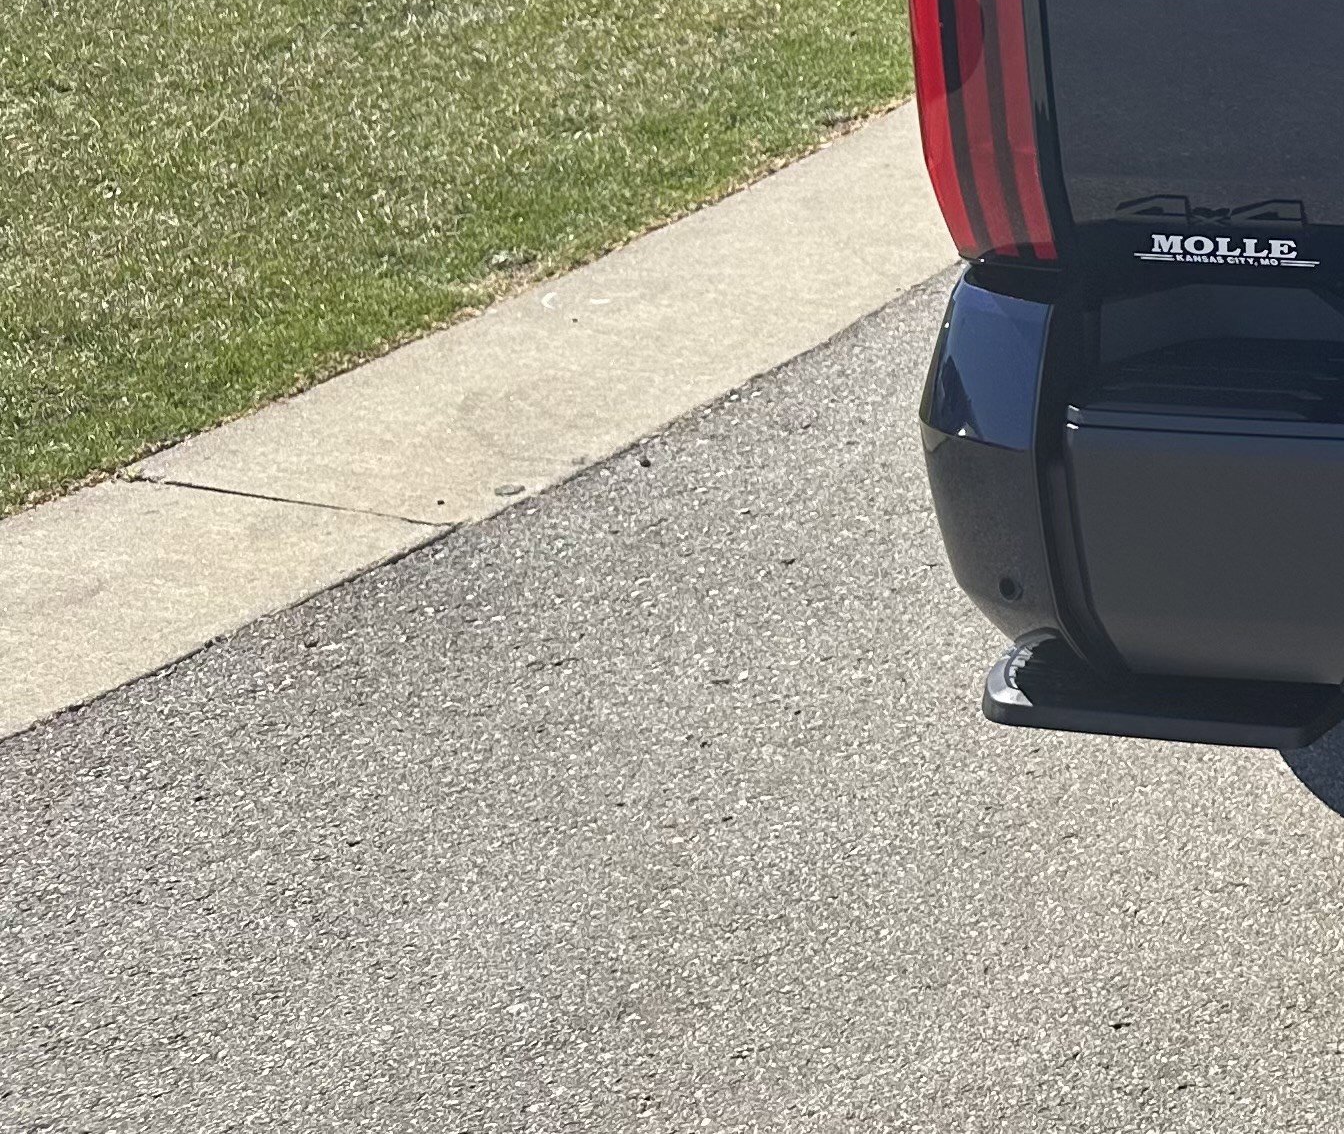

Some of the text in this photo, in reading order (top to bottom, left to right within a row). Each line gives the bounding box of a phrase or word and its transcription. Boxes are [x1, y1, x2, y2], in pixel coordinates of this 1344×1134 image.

[1150, 234, 1298, 259] MOLLE
[1175, 253, 1279, 267] KANSAS CITY, MO
